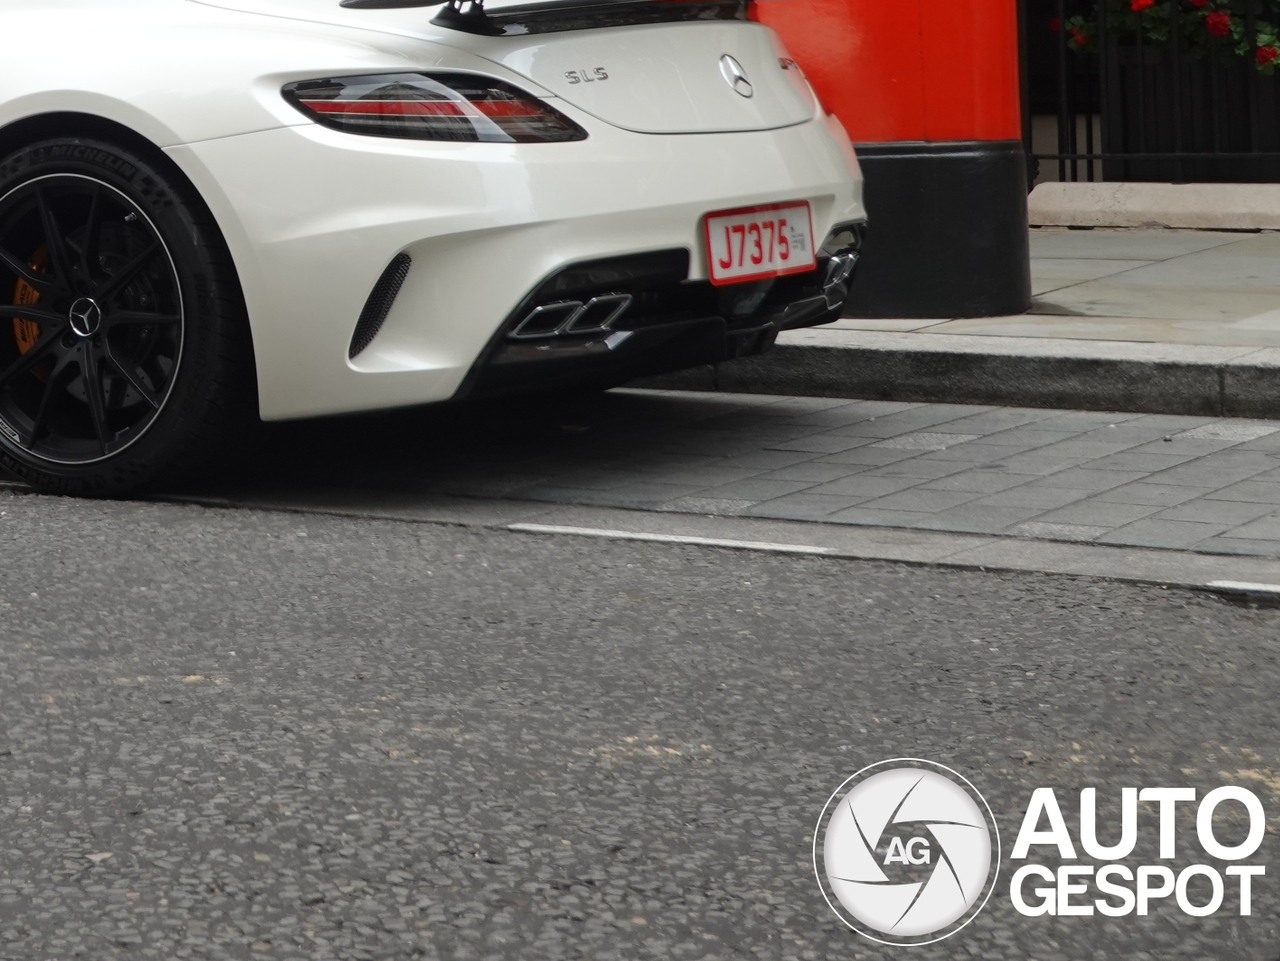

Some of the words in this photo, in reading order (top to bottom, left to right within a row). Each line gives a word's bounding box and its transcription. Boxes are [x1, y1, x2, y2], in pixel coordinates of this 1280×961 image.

[564, 67, 609, 85] SLS
[51, 145, 136, 179] MICHELIN
[718, 218, 790, 270] J7375
